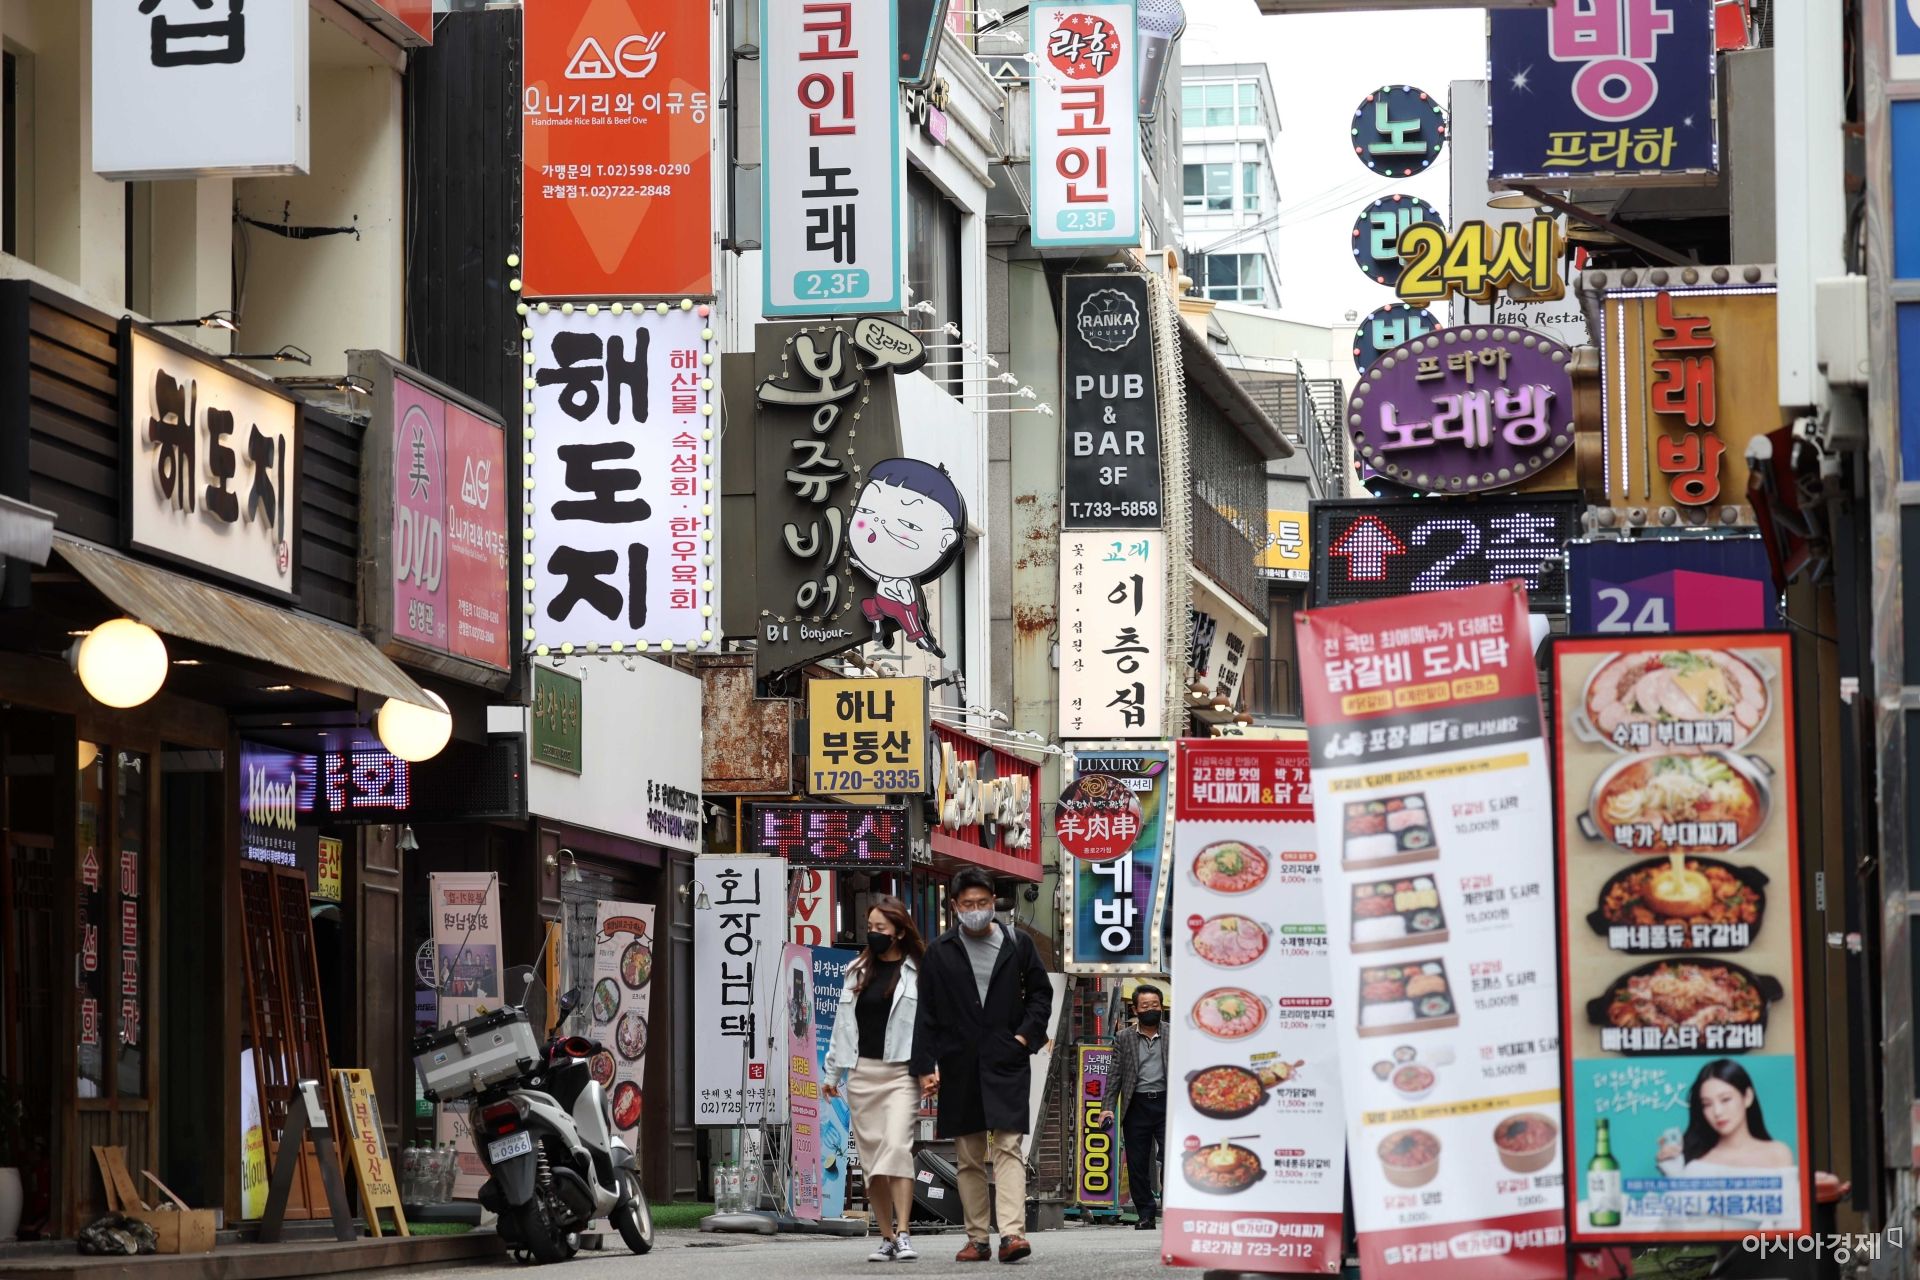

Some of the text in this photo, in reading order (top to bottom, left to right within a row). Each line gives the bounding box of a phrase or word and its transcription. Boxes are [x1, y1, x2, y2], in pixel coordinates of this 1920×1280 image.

[1050, 22, 1112, 73] 락휴
[1548, 0, 1674, 122] 방
[524, 87, 708, 124] 오니기리와 이규동
[531, 117, 648, 125] Handmade Rice Ball & Beef Ove
[1056, 85, 1110, 203] 코인
[1542, 127, 1677, 168] 프라하
[542, 164, 691, 179] 가맹문의 T.02)598-0290
[542, 185, 577, 199] 관철점
[1067, 213, 1109, 231] 2,3F
[1399, 217, 1550, 297] 24시
[807, 273, 861, 296] 2,3F
[1082, 313, 1134, 328] RANKA
[1089, 329, 1127, 337] HOUSE
[1498, 312, 1529, 328] BBQ
[1075, 373, 1144, 400] PUB
[1652, 290, 1726, 506] 노래방
[1103, 405, 1117, 424] &
[1379, 384, 1556, 450] 노래방
[1074, 431, 1145, 456] BAR
[146, 369, 287, 546] 해도지
[409, 424, 430, 502] 美
[535, 327, 652, 630] 해도지
[757, 331, 860, 617] 봉쥬비어
[1099, 466, 1127, 485] 3F
[1070, 501, 1158, 518] T.733-5858
[397, 507, 442, 593] DVD
[1102, 540, 1150, 562] 교대
[1411, 512, 1560, 592] 2층
[408, 599, 434, 636] 상영관
[1597, 587, 1670, 632] 24
[1101, 573, 1150, 729] 이층집
[1325, 637, 1510, 693] 닭갈비 도시락
[836, 690, 895, 722] 하나
[1656, 720, 1735, 747] 부대찌개
[823, 731, 911, 765] 부동산
[1078, 758, 1143, 773] LUXURY
[1215, 768, 1236, 781] 진한
[1239, 768, 1260, 781] 맛의
[813, 770, 920, 790] T.720-3335
[1192, 782, 1260, 804] 부대찌개
[1261, 787, 1274, 804] &
[248, 762, 296, 832] Kloud
[761, 812, 897, 859] 부동산
[1057, 813, 1137, 842] 羊肉串
[1661, 822, 1739, 847] 부대찌개
[1691, 923, 1750, 949] 닭갈비
[714, 868, 762, 1060] 회장님댁
[1704, 1024, 1765, 1049] 닭갈비
[723, 1088, 733, 1100] 및
[1707, 1194, 1784, 1217] 처음처럼
[1247, 1242, 1313, 1258] 723-2112
